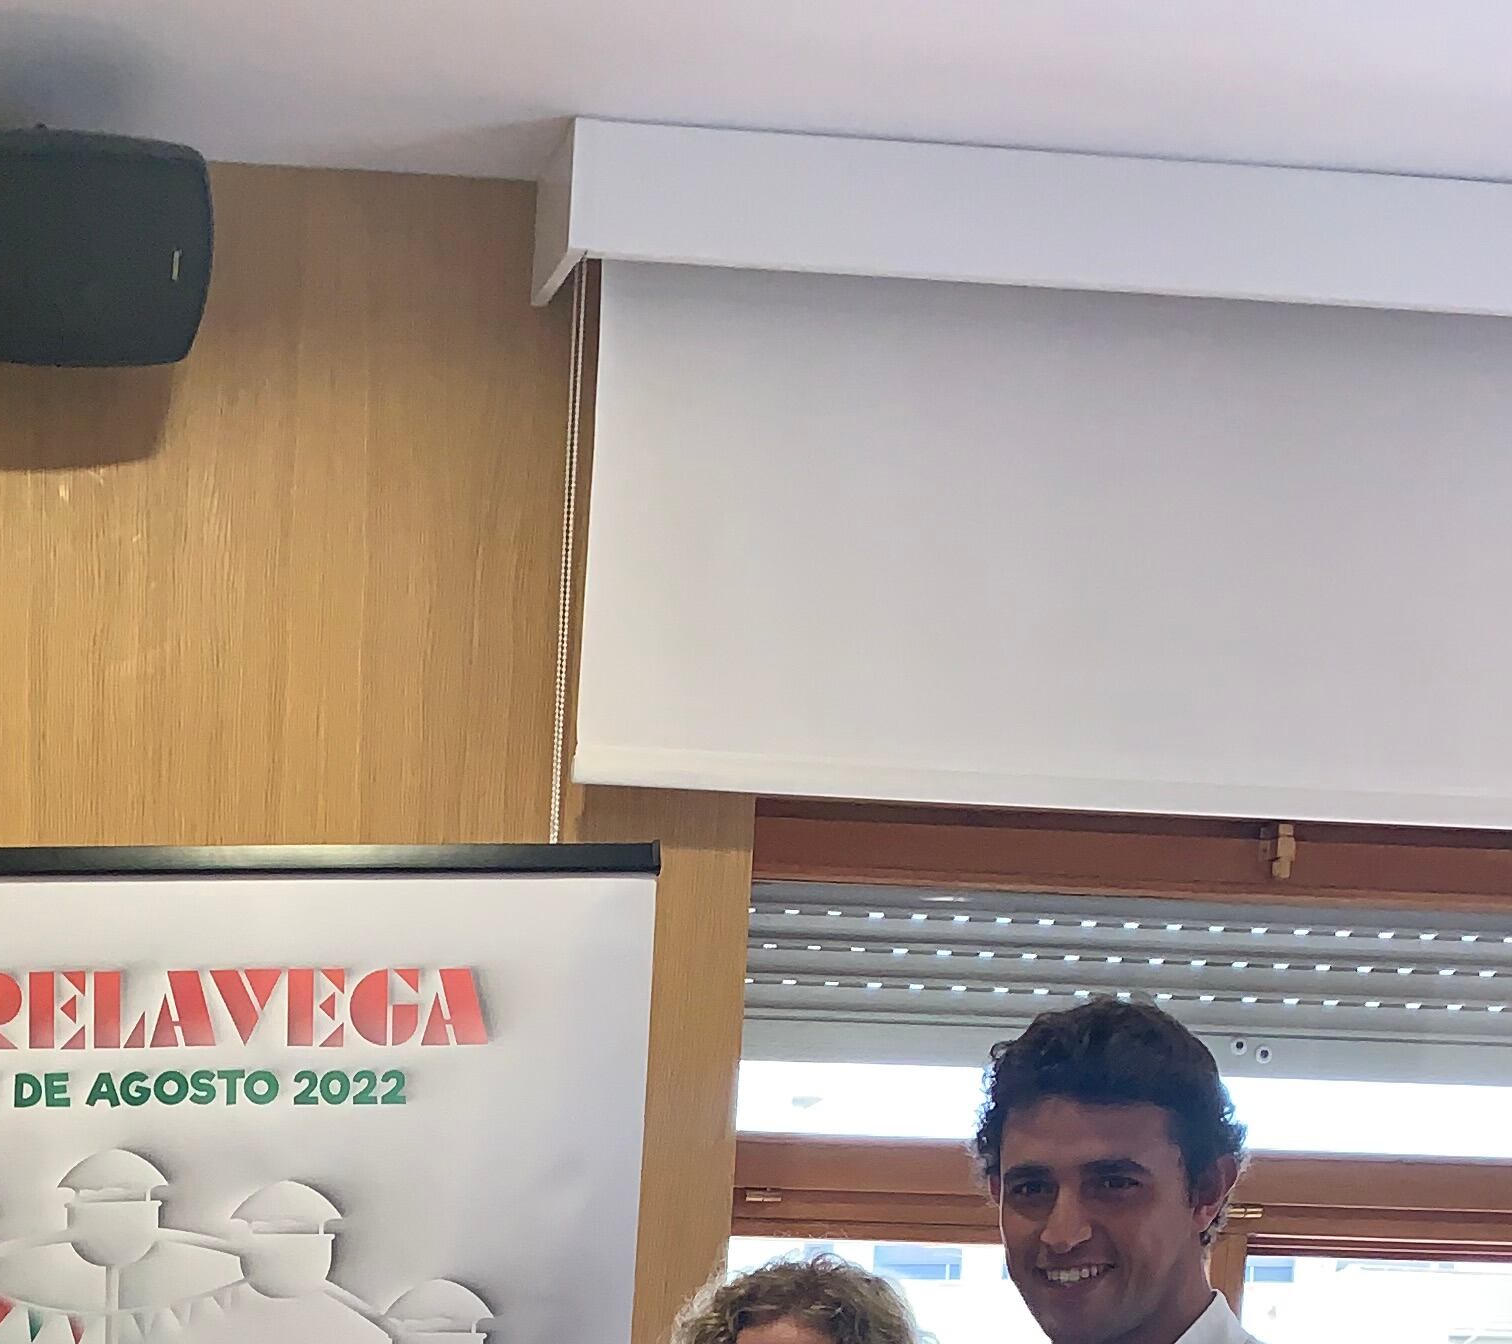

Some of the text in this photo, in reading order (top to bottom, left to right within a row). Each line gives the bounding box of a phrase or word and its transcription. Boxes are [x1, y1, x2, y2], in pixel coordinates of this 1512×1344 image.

[13, 1071, 72, 1109] DE
[84, 1068, 283, 1109] AGOSTO
[292, 1068, 407, 1106] 2022
